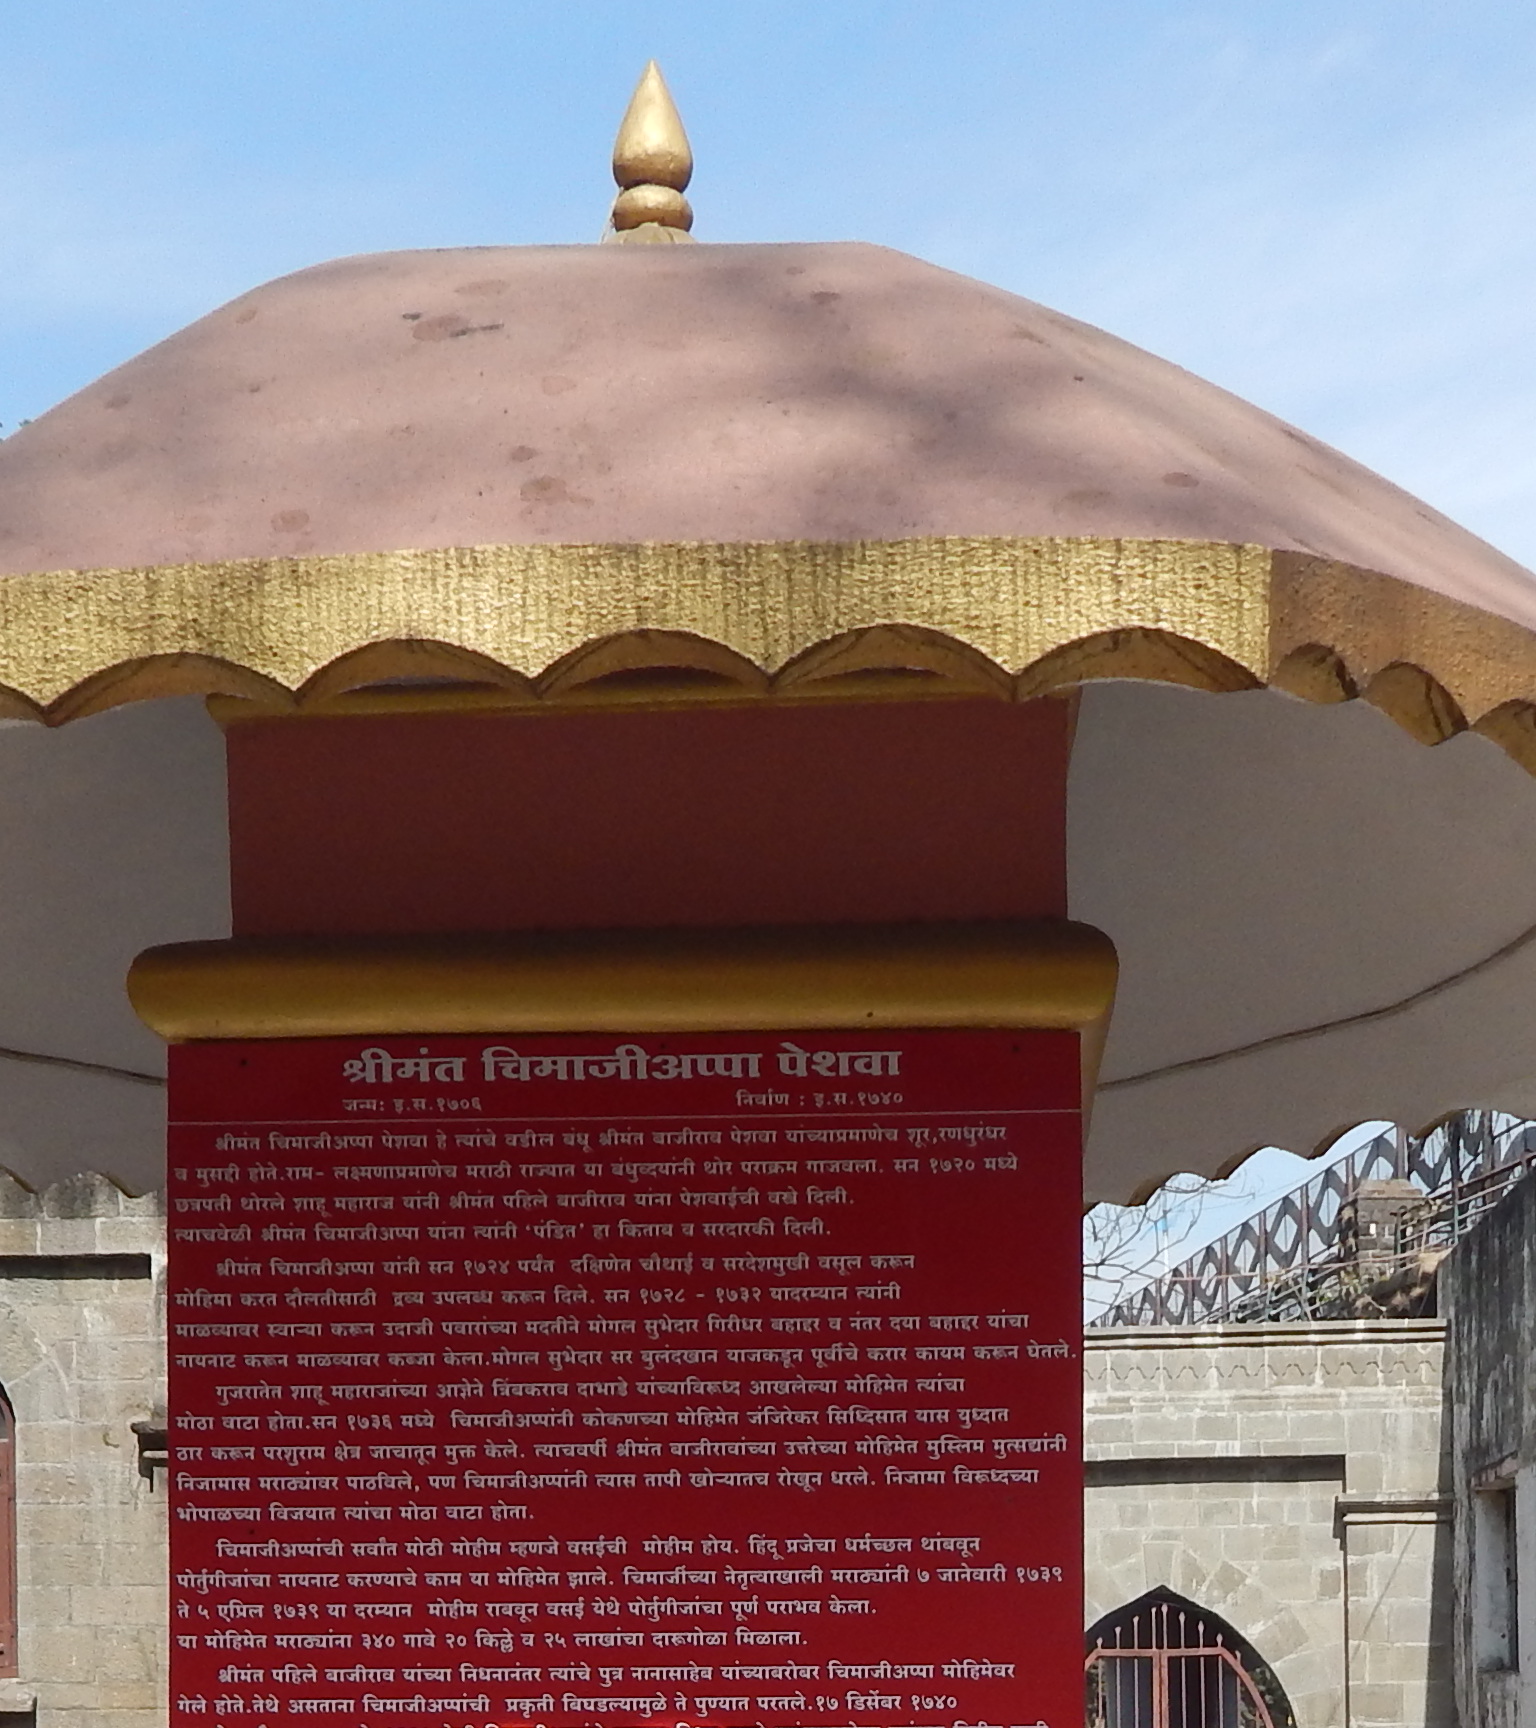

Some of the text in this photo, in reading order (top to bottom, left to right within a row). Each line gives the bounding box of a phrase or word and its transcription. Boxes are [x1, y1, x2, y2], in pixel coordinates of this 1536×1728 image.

[342, 1041, 903, 1082] श्रीमंत चिमाजीअप्पा पेशवा
[735, 1088, 789, 1105] निर्वाण
[214, 1126, 722, 1150] श्रीमंत चिमाजीअप्पा पेशवा त्यांचे श्रीमंत बाजीराव
[465, 1151, 1018, 1178] मराठी राज्यात थोर पराक्रम १७२० मध्ये
[240, 1189, 625, 1211] थोरले महाराज श्रीमंत बाजीराव
[173, 1217, 775, 1241] त्याचवेळी चिमाजीअप्पा त्यांनी सरदारकी
[216, 1251, 810, 1276] श्रीमंत चिमाजीअप्पा यांनी पर्यंत दक्षिणेत सरदेशमुखी
[173, 1280, 901, 1308] मोहिमा दौलतीसाठी द्रव्य उपलब्ध यादरम्यान त्यांनी
[381, 1308, 1029, 1339] उदाजी पवारांच्या मदतीने सुभेदार गिरीधर यांचा
[174, 1342, 859, 1370] नायनाट माळव्यावर सुभेदार बुलंदखान याजकडून पूर्वीचे
[214, 1372, 965, 1405] गुजरातेत त्रिंबकराव आखलेल्या मोहिमेत त्यांचा
[174, 1405, 819, 1430] मोठा वाटा मध्ये कोकणच्या मोहिमेत जंजिरेकर
[262, 1435, 847, 1466] परशुराम क्षेत्र जाचातून त्याचवर्षी श्रीमंत उत्तरेच्या
[175, 1465, 946, 1492] निजामास मराठ्यांवर त्यास तापी रोखून निजामा
[176, 1501, 392, 1521] भोपाळच्या विजयात त्यांचा
[350, 1531, 981, 1557] सर्वांत मोहीम म्हणजे प्रजेचा धर्मच्छल थांबवून
[277, 1562, 1007, 1587] नायनाट करण्याचे मोहिमेत चिमाजींच्या मराठ्यांनी जानेवारी
[216, 1595, 821, 1622] एप्रिल दरम्यान मोहीम राबवून पूर्ण पराभव
[203, 1626, 727, 1650] मोहिमेत मराठ्यांना ३४० गावे लाखांचा दारूगोळा
[218, 1662, 591, 1682] श्रीमंत बाजीराव यांच्या निधनानंतर त्यांचे
[176, 1690, 901, 1717] गेले असताना प्रकृती पुण्यात डिसेंबर
